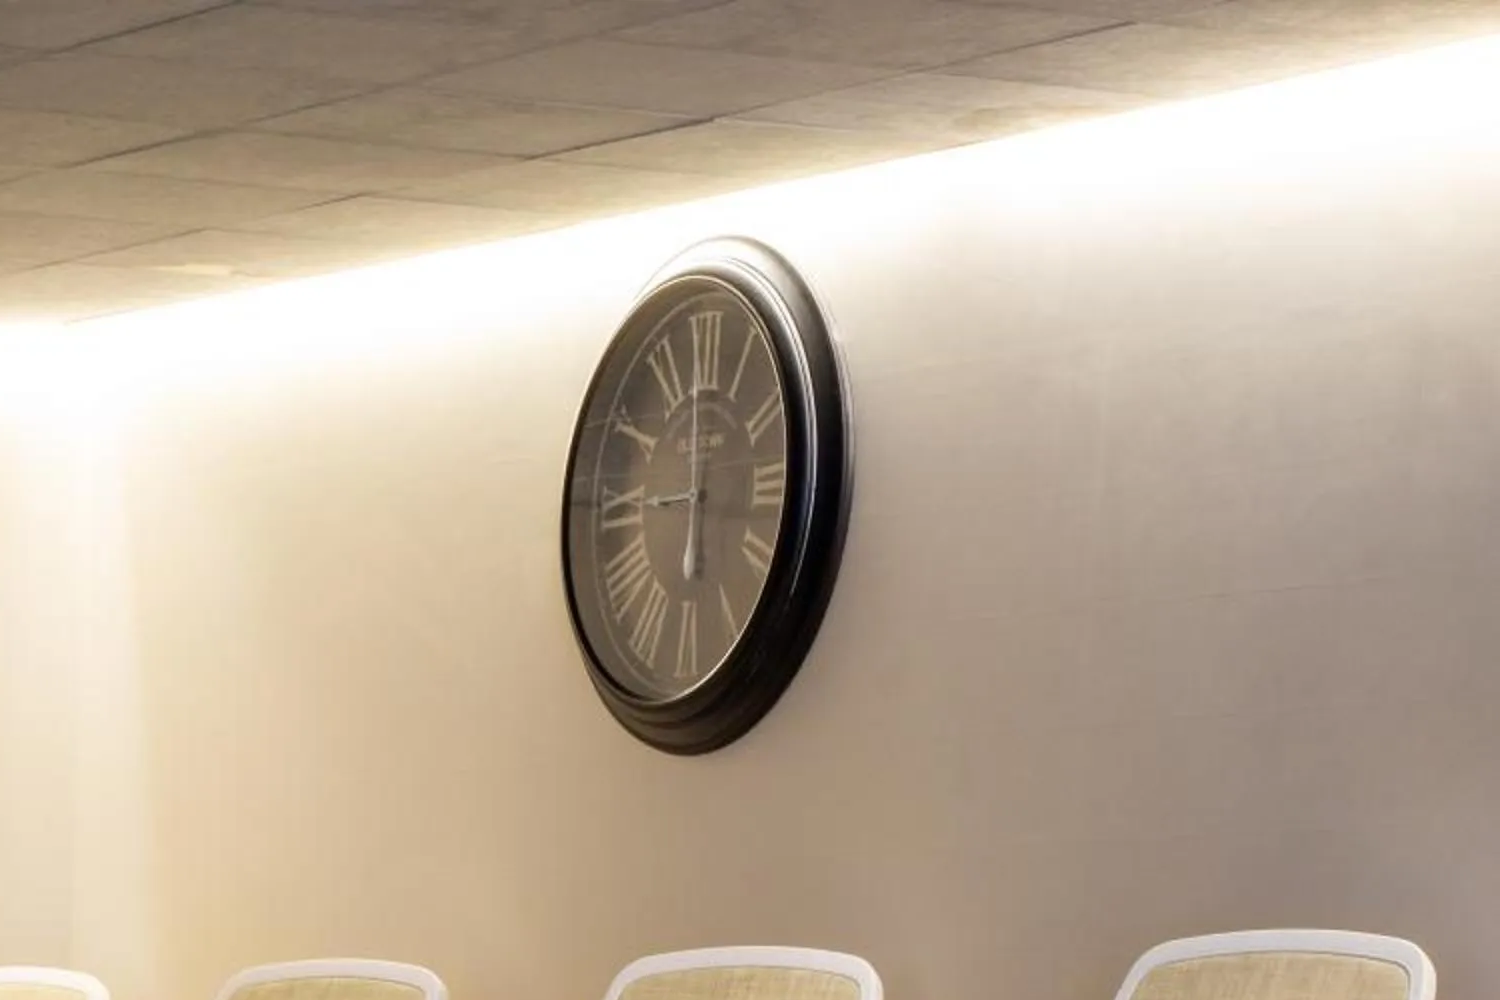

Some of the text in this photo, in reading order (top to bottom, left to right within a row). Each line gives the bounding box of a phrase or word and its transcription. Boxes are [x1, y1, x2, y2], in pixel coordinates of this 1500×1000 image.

[648, 334, 684, 421] XI
[689, 312, 723, 391] XII
[602, 486, 645, 529] IX
[606, 532, 651, 623] VIII
[630, 577, 668, 668] VII
